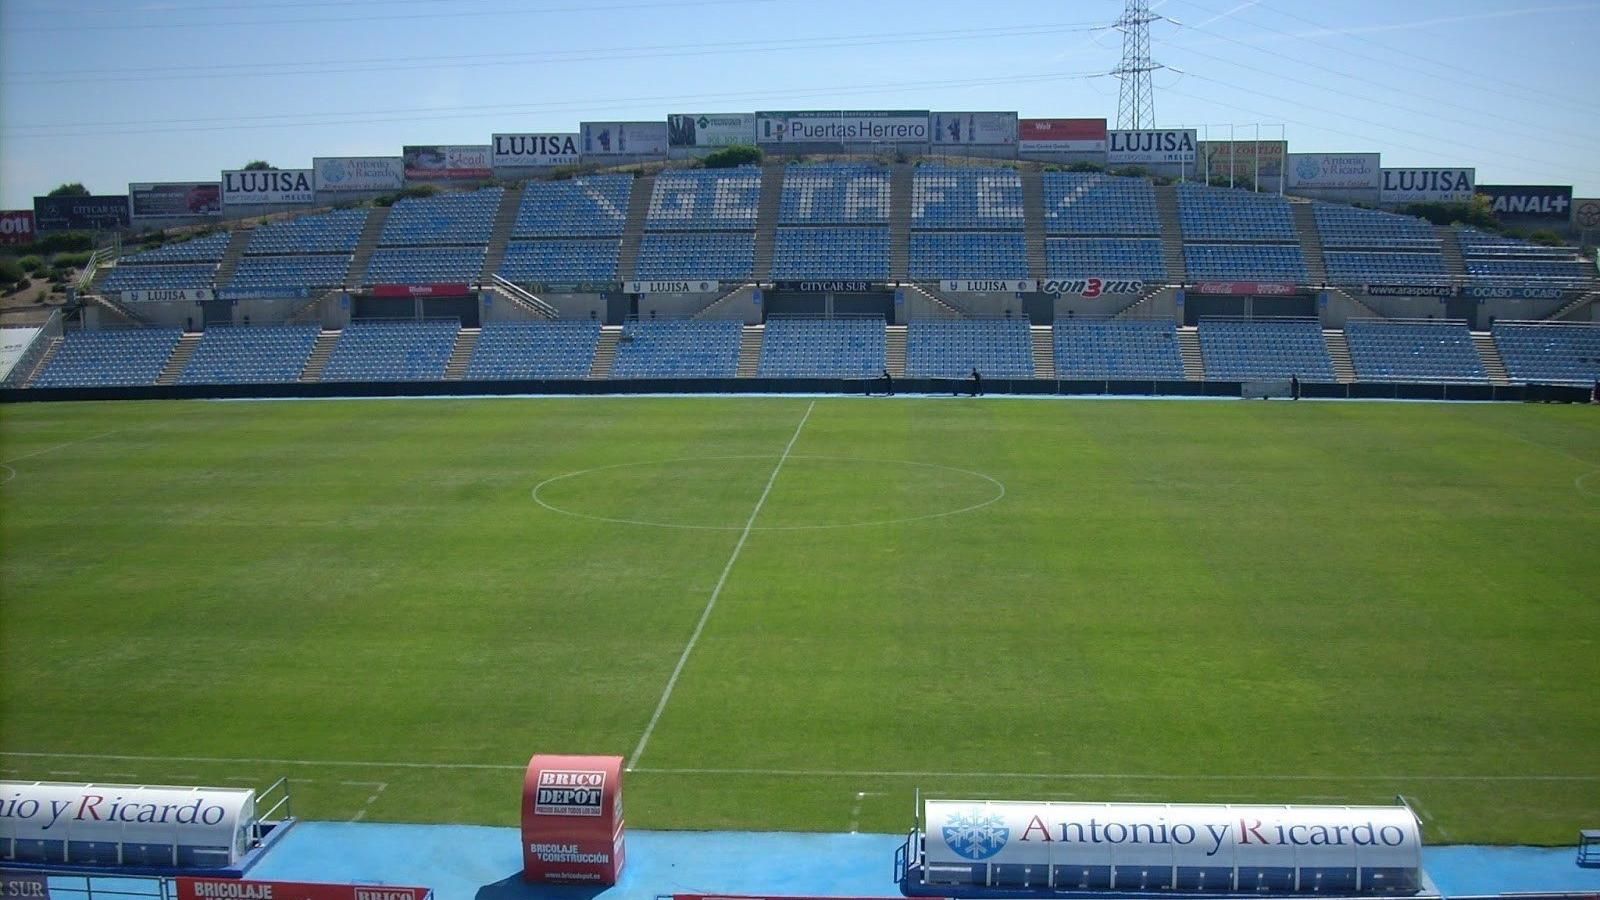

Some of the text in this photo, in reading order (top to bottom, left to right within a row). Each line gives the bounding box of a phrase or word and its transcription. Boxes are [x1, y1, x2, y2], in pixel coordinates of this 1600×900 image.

[792, 121, 925, 137] Puertas Herrero
[495, 136, 578, 155] LUJISA
[1110, 132, 1194, 151] LUJISA
[225, 172, 311, 193] LUJISA
[1383, 171, 1471, 191] LUJISA
[646, 176, 1024, 219] GETAFE
[649, 281, 690, 292] LUJISA
[800, 281, 867, 291] CITYCAR SUR
[967, 280, 1008, 291] LUJISA
[1473, 287, 1564, 299] OCASO OCASO
[147, 290, 187, 300] LUJISA
[541, 772, 602, 786] BRICO
[0, 793, 225, 829] io y Ricardo
[1019, 814, 1405, 856] Antonio y Ricardo
[530, 843, 579, 854] BRICOLAJE
[9, 881, 44, 898] SUR
[194, 881, 273, 900] BRICOLAJE
